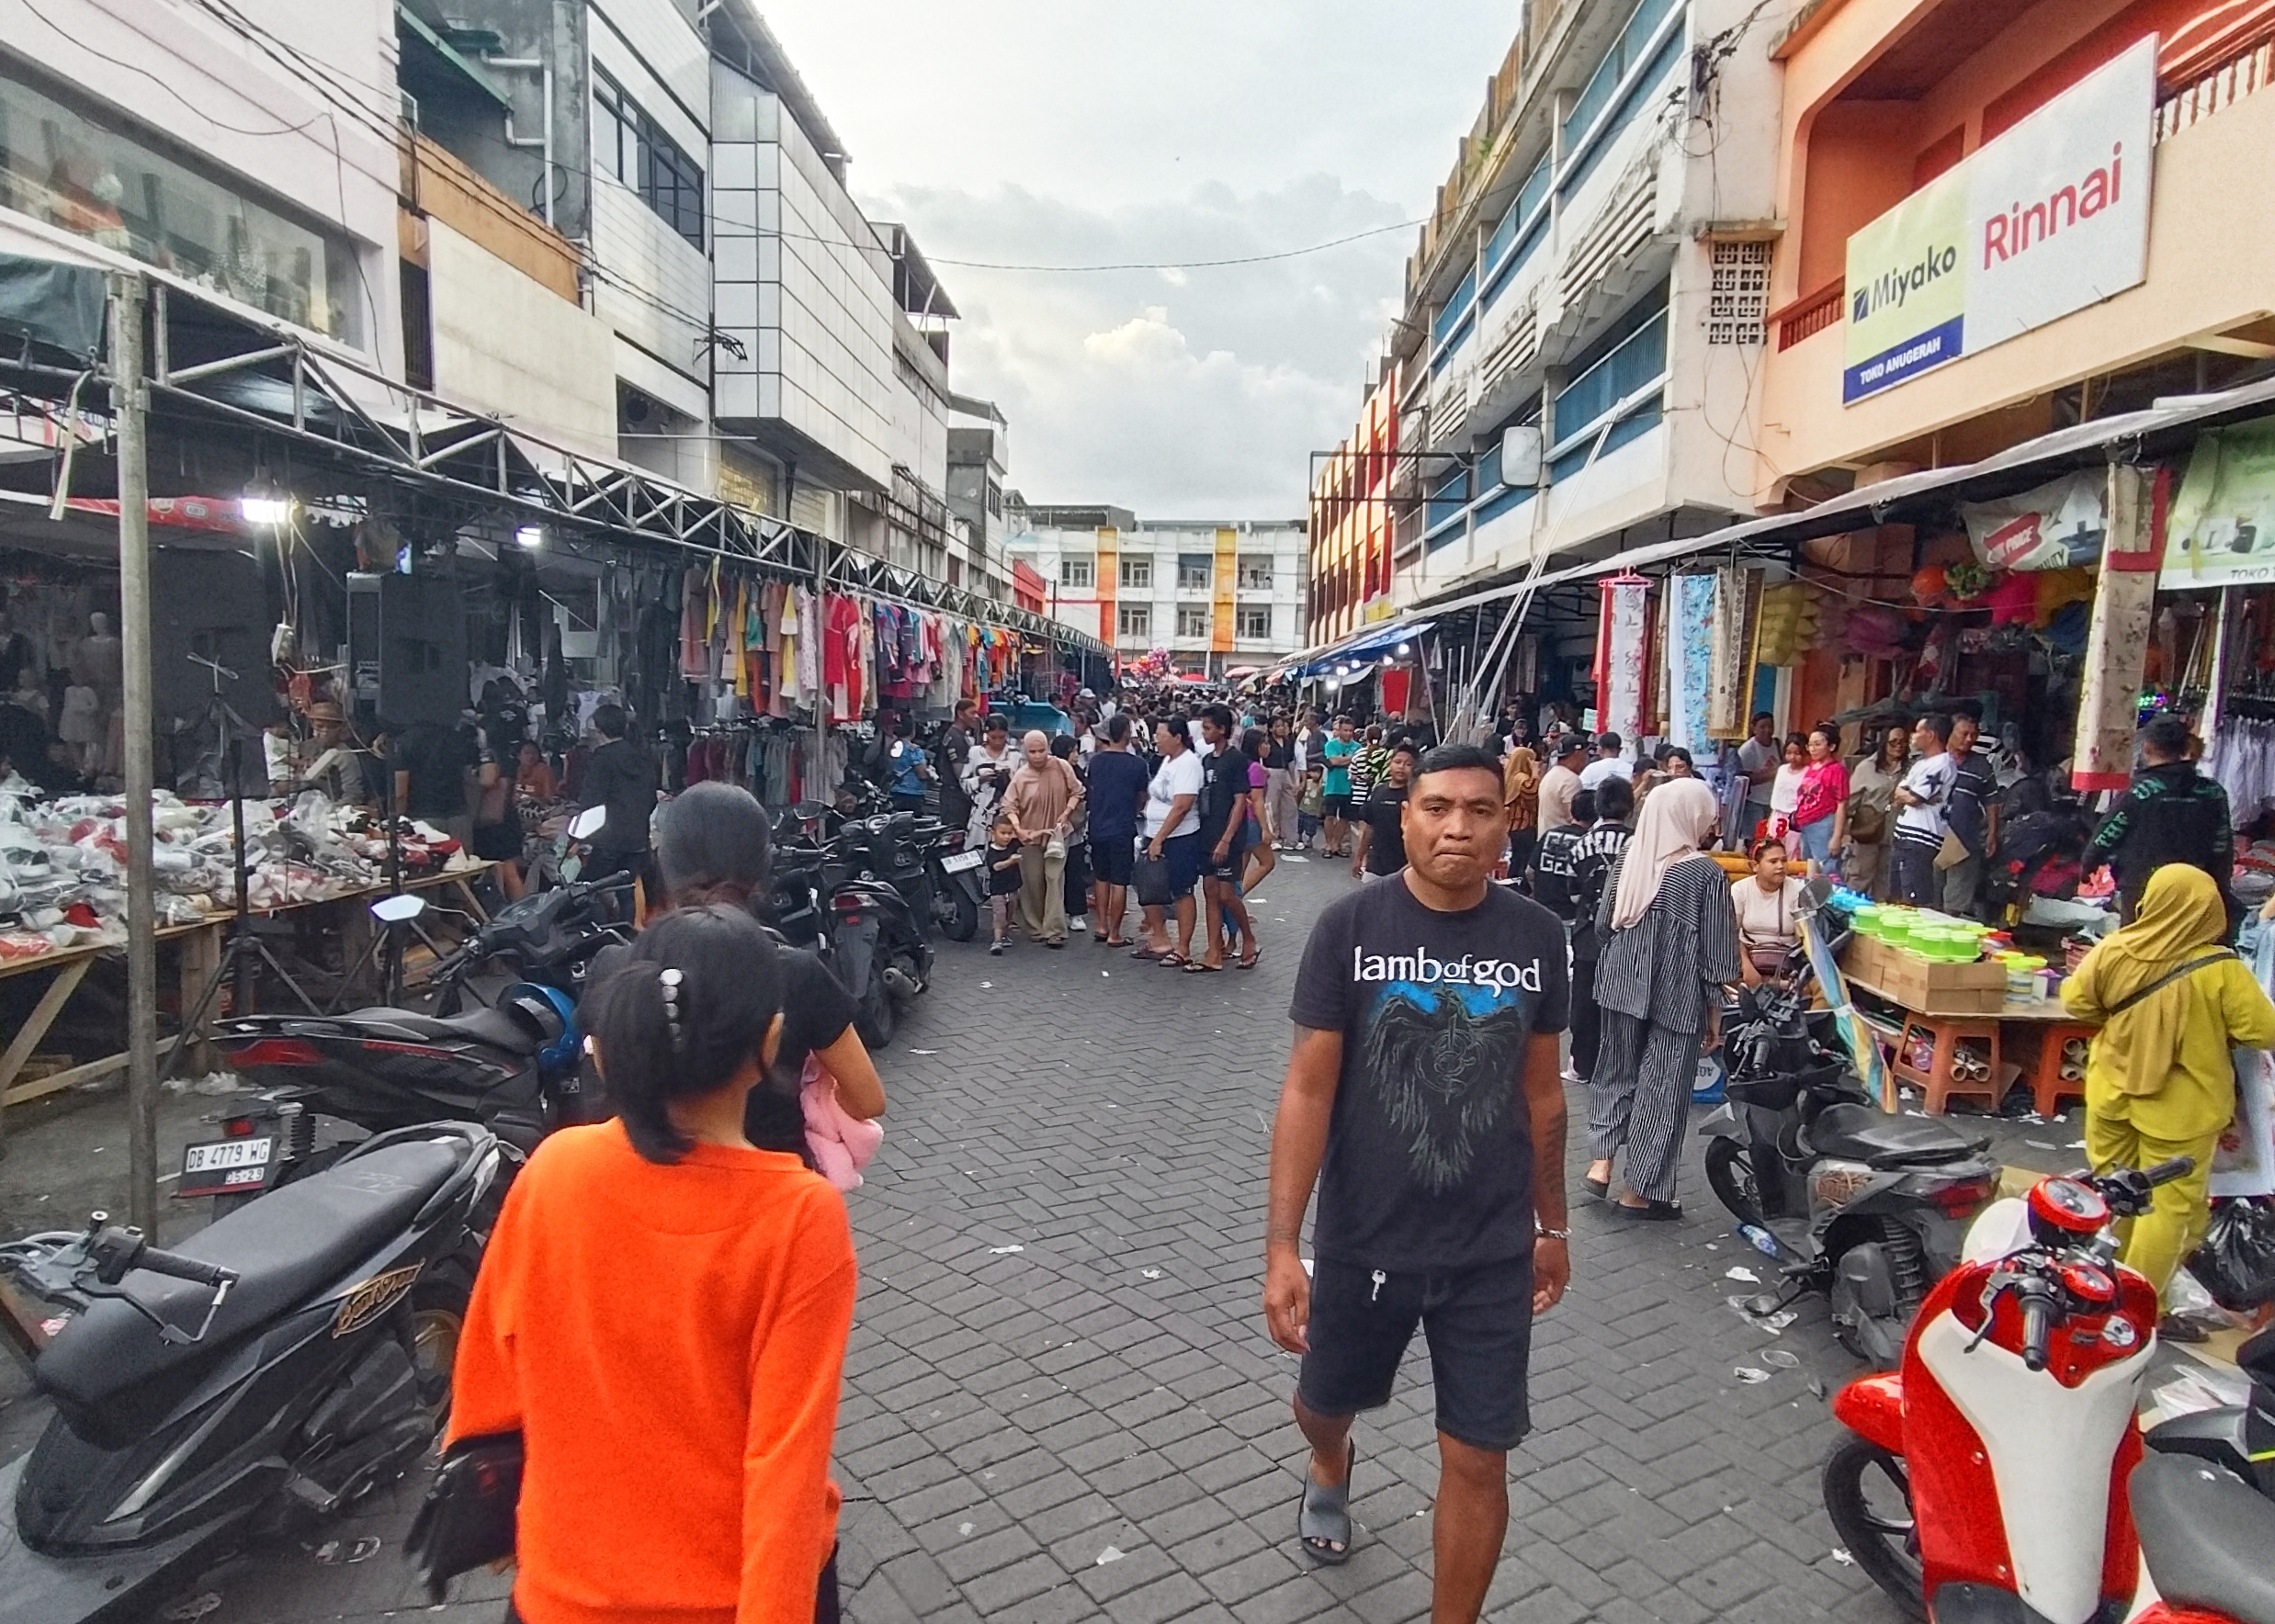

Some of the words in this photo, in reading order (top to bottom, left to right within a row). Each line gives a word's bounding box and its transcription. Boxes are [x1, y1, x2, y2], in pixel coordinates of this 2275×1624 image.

[1983, 141, 2122, 271] Rinnai
[1871, 244, 1957, 313] Miyako
[1860, 364, 1885, 385] TOKO
[1885, 335, 1941, 374] ANUGERAH
[2006, 524, 2034, 555] PRICE
[2230, 567, 2269, 581] TOKO
[1353, 945, 1443, 983] lamb
[1443, 953, 1474, 984] of
[1473, 958, 1543, 998] god
[187, 1149, 205, 1169] DB
[209, 1144, 243, 1166] 4779
[249, 1141, 268, 1161] WG
